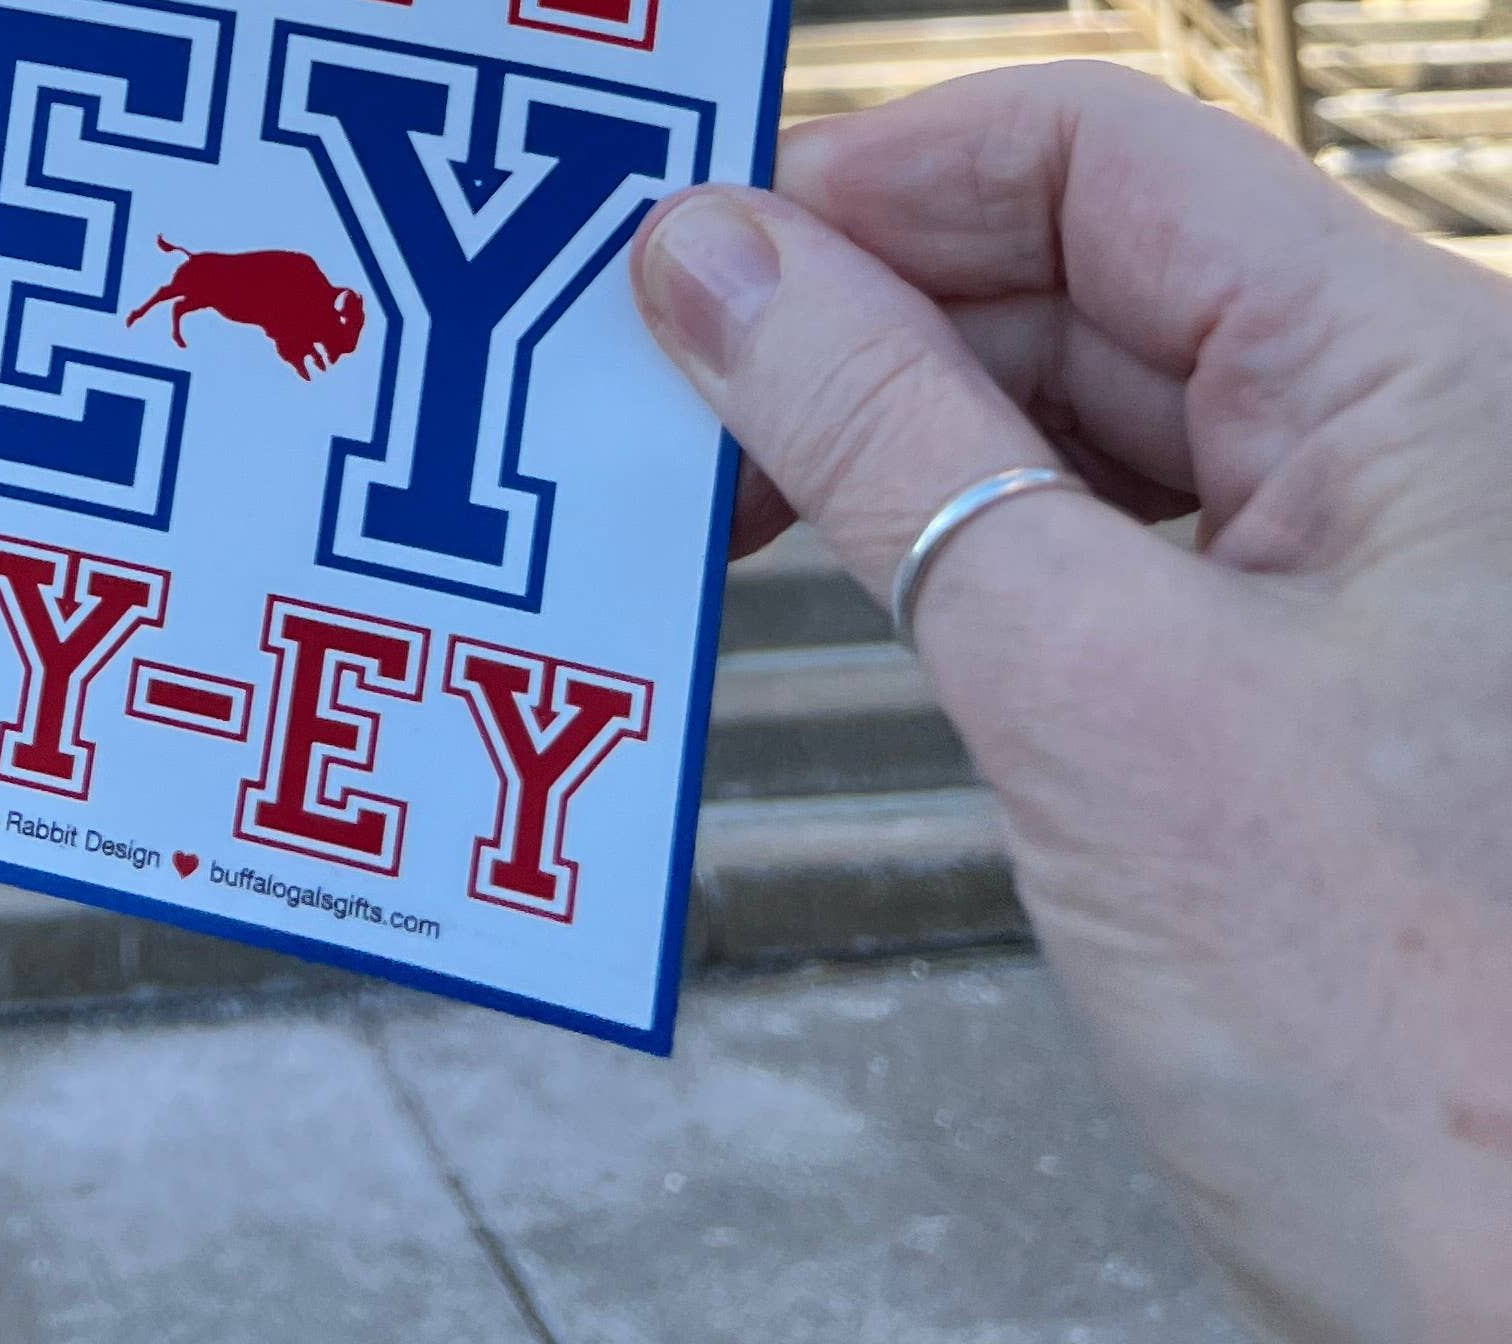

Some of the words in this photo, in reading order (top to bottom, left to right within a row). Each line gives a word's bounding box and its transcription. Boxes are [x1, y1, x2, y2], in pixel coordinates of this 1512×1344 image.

[5, 810, 78, 849] Rabbit
[84, 829, 162, 870] Design
[208, 859, 442, 940] buffalogalsgifts.com
